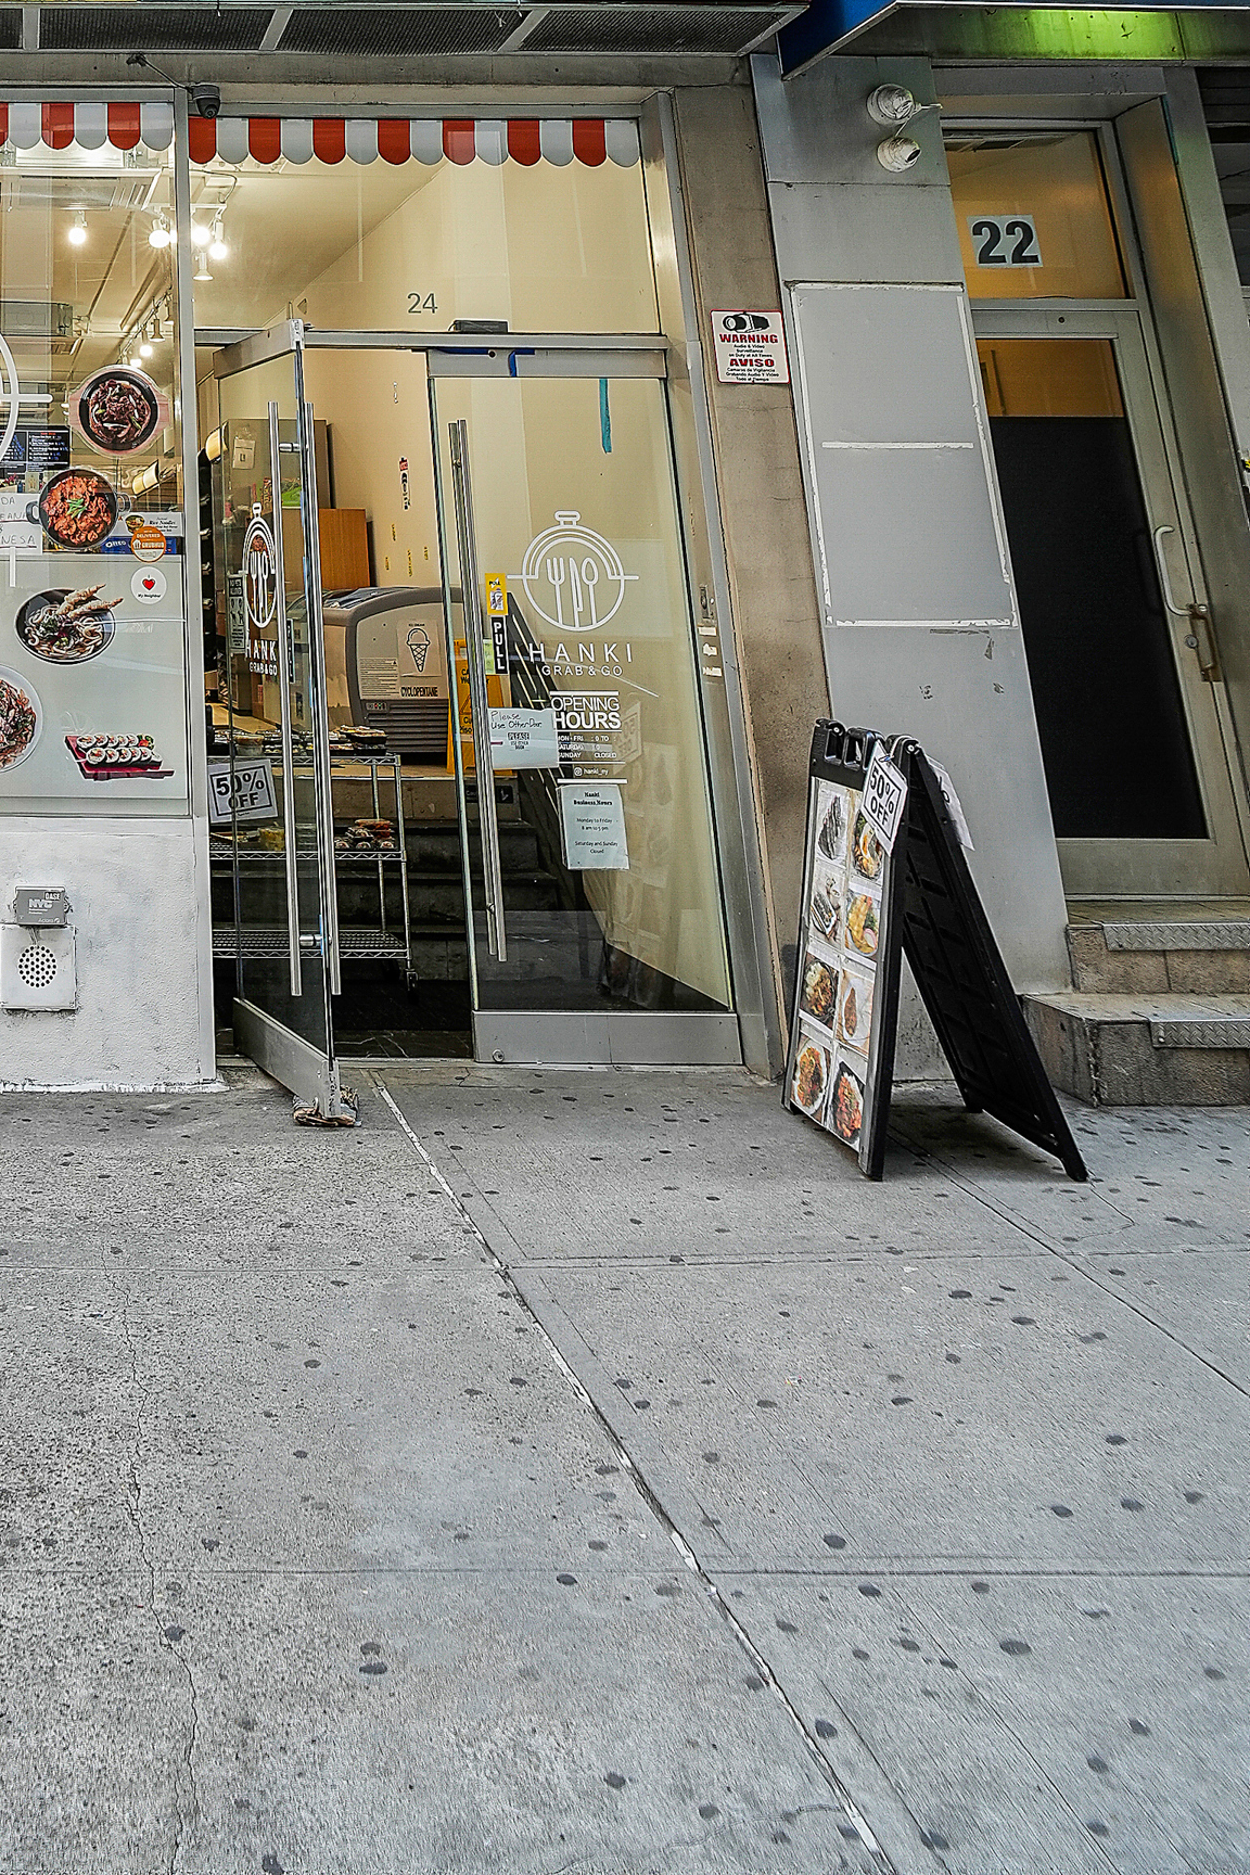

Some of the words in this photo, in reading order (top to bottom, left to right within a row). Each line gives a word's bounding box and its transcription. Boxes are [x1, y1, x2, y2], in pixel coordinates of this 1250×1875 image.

[972, 220, 1040, 264] 22
[407, 292, 439, 314] 24
[719, 333, 779, 344] WARNING
[729, 358, 775, 367] AVISO
[245, 638, 277, 662] HANK
[493, 621, 505, 670] PULL
[529, 643, 633, 663] HANKI
[541, 665, 584, 675] GRAB
[588, 665, 596, 675] &
[601, 665, 623, 676] GO
[400, 687, 438, 697] CYCLOPENTANE
[551, 696, 620, 711] OPENING
[491, 710, 521, 722] Please
[553, 711, 622, 729] HOURS
[216, 771, 265, 796] 50%
[870, 765, 895, 815] 50%
[228, 792, 258, 809] OFF
[870, 796, 889, 826] OFF
[28, 898, 52, 909] NYC
